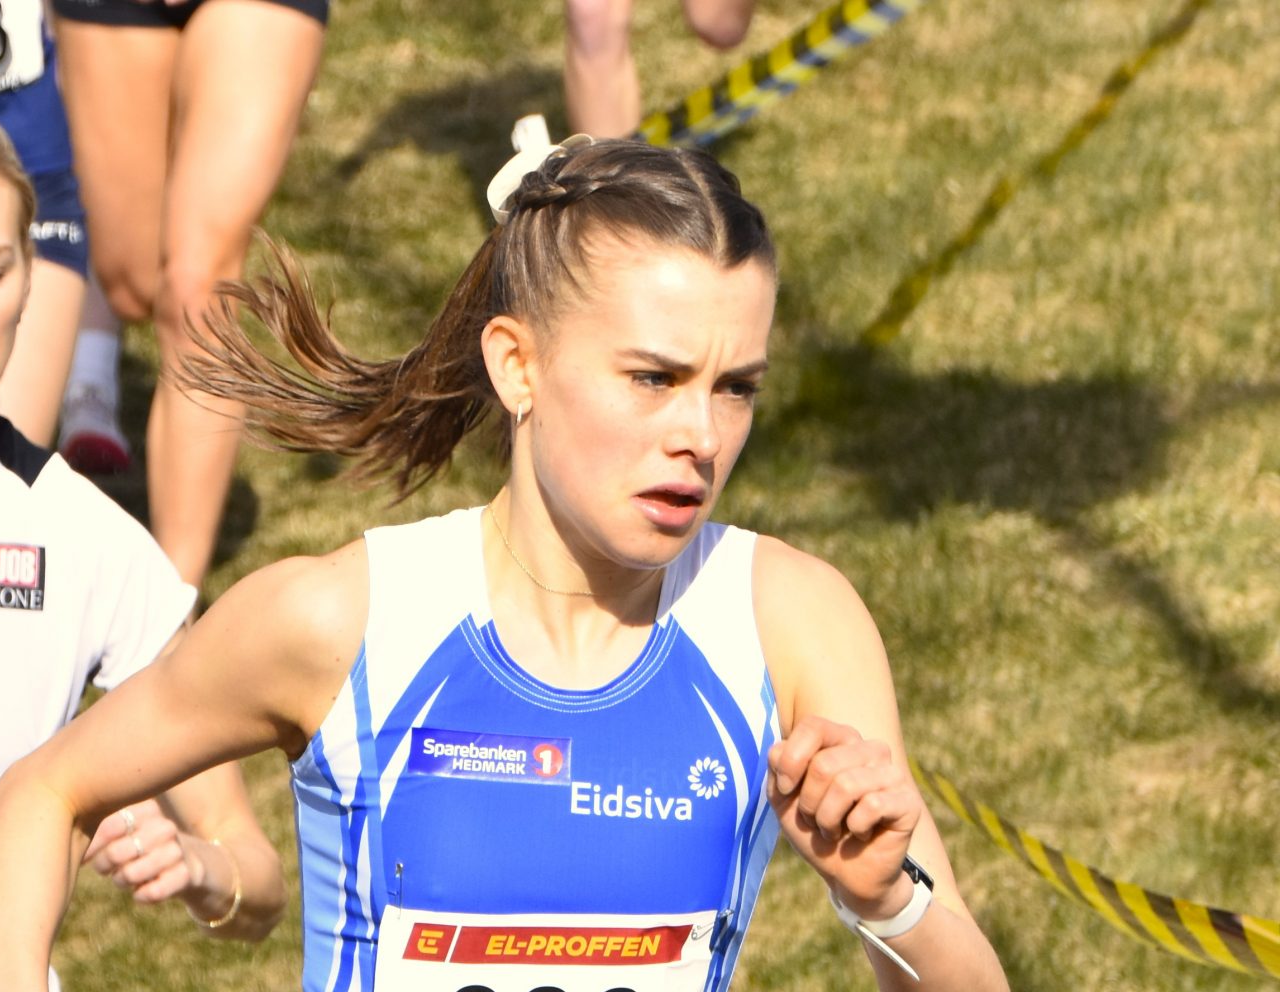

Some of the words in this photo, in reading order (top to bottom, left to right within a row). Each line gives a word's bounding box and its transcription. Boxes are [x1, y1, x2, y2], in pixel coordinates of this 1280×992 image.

[423, 738, 526, 762] Sparebanken
[452, 757, 525, 775] HEDMARK
[571, 781, 693, 820] Eidsiva
[485, 934, 661, 957] EL-PROFFEN
